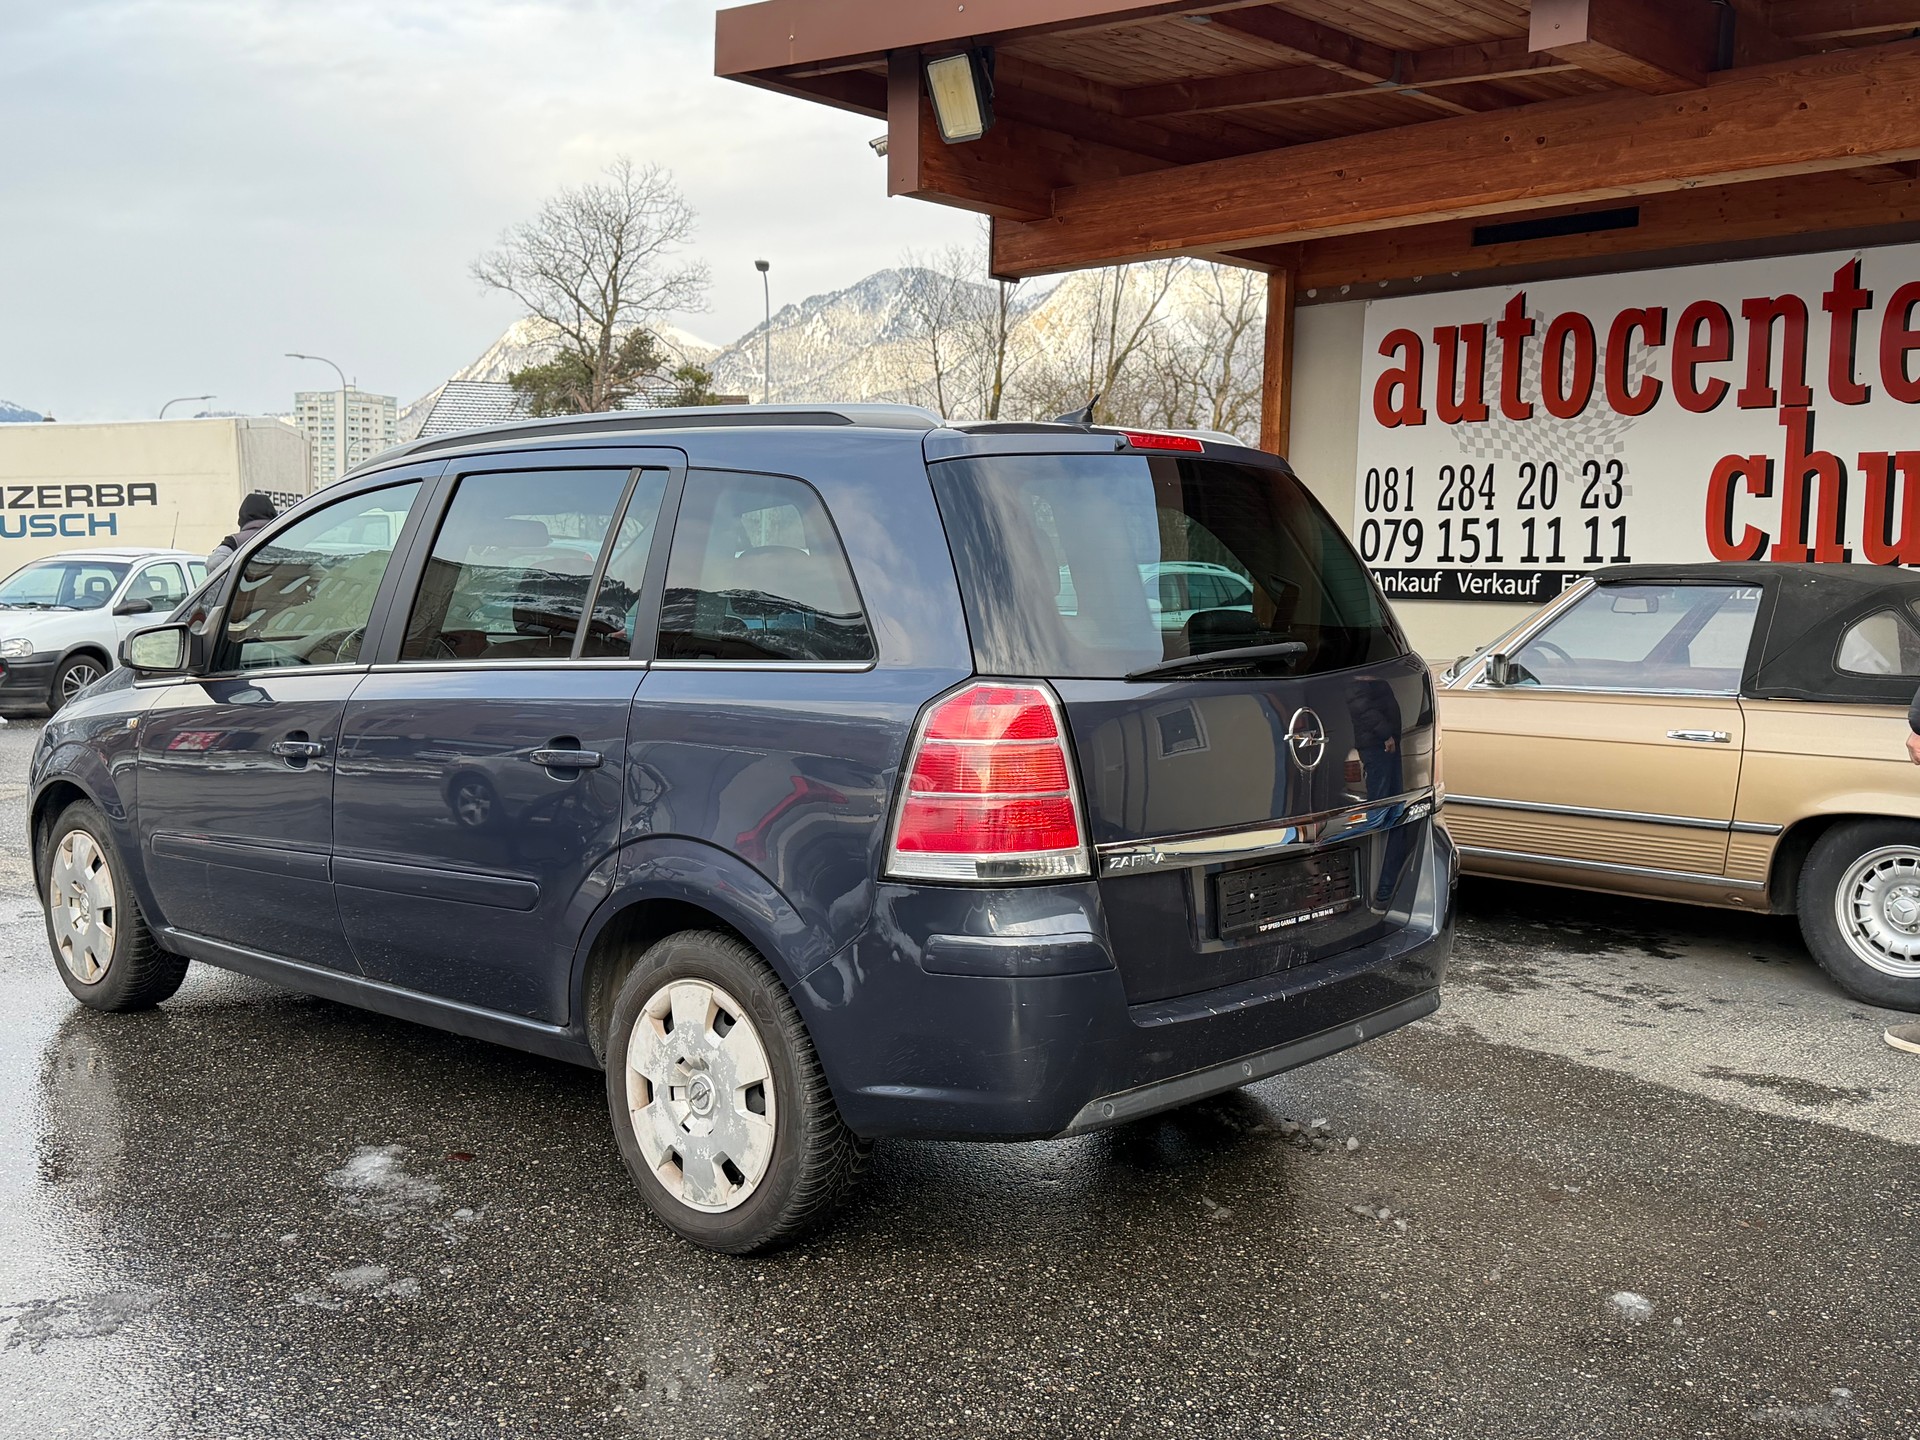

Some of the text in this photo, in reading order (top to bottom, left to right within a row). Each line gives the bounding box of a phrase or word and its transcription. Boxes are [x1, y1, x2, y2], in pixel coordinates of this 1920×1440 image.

[1373, 257, 1920, 428] autocente
[1364, 459, 1624, 512] 081 284 20 23
[1705, 405, 1920, 565] chu
[0, 512, 117, 538] USCH
[1360, 515, 1631, 563] 079 151 11 11
[1373, 571, 1443, 593] Ankauf
[1456, 572, 1542, 595] Verkauf
[1110, 852, 1167, 869] ZAFIRA
